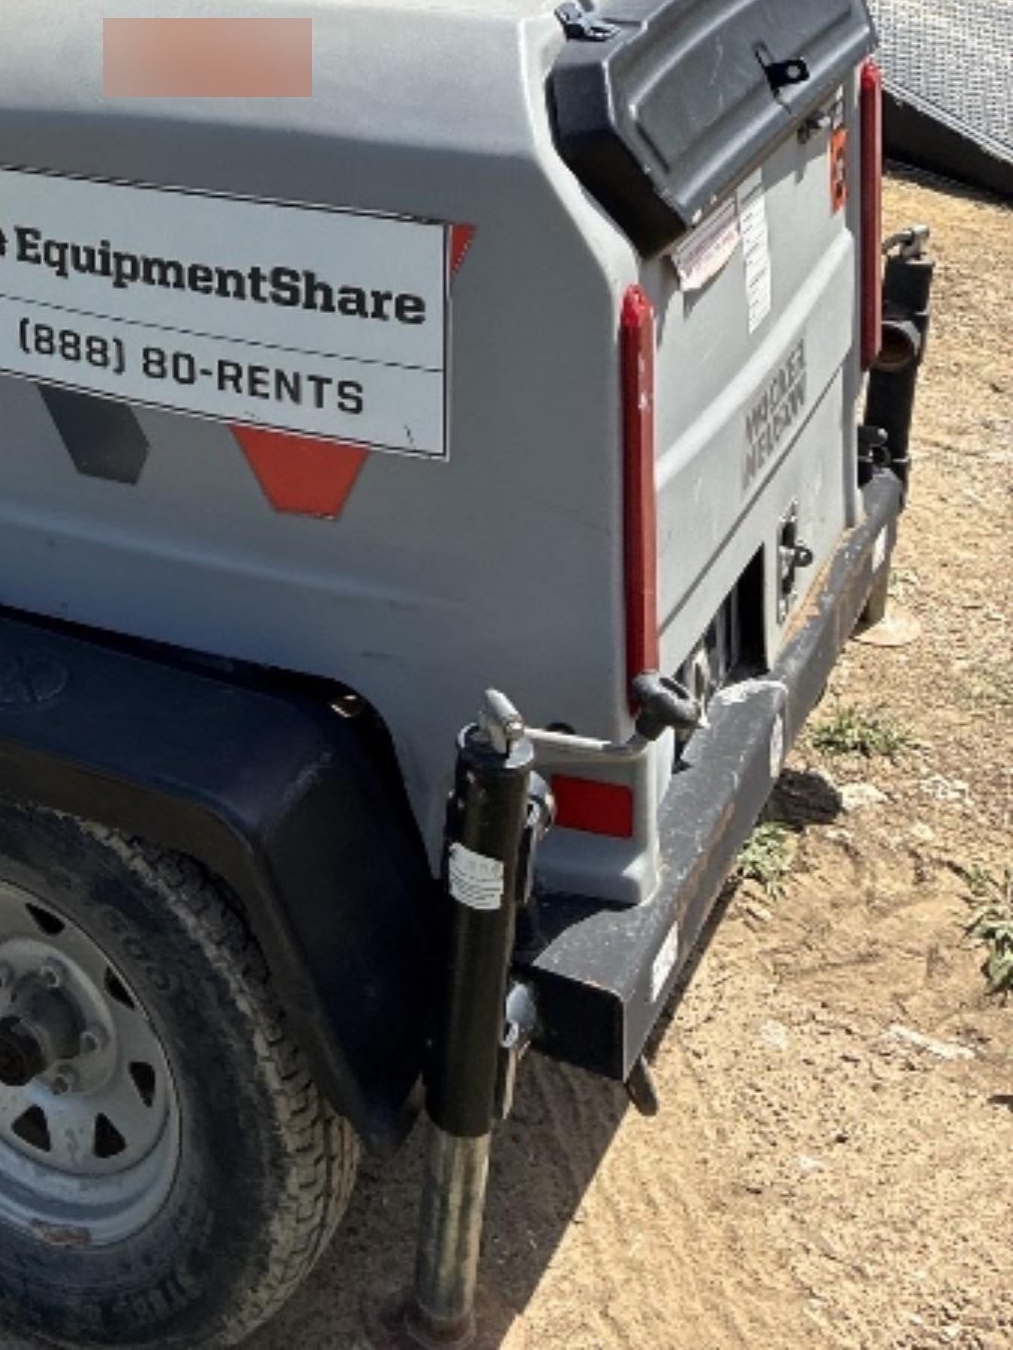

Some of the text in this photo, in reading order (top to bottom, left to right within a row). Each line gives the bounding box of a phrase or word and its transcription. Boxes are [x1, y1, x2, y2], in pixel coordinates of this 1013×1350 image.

[14, 225, 426, 324] EquipmentShare
[19, 318, 364, 415] (888) 80-RENTS
